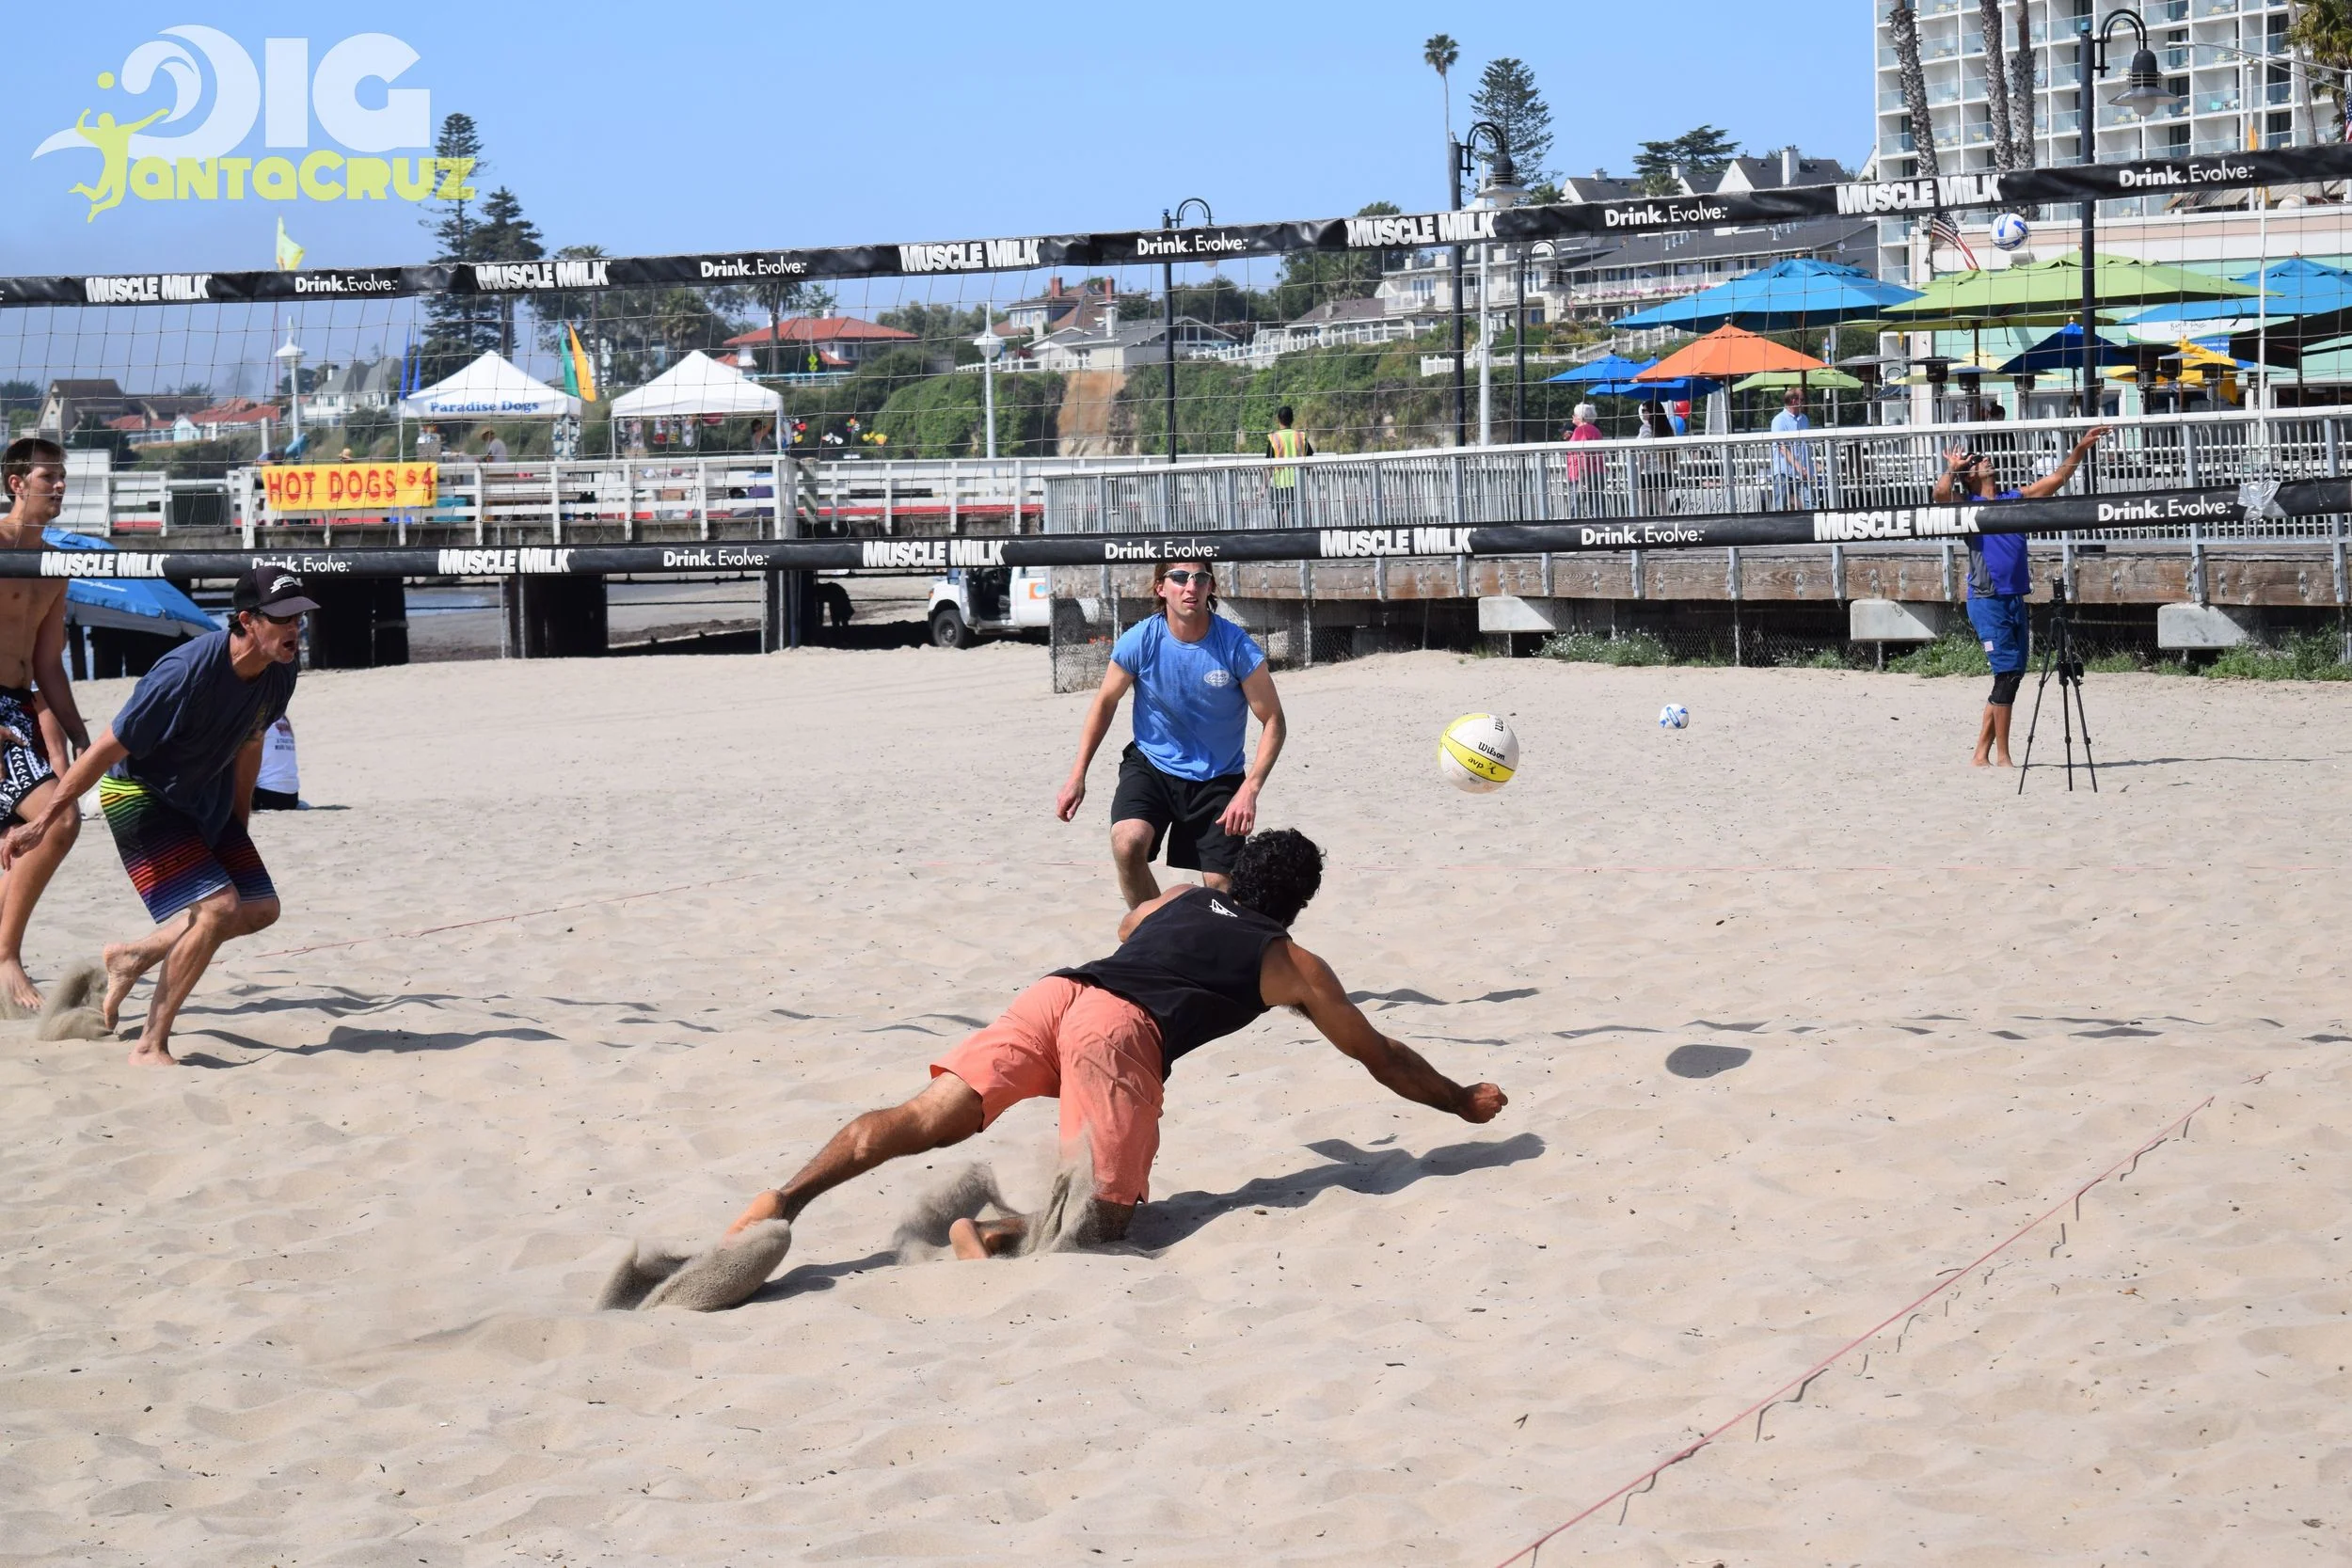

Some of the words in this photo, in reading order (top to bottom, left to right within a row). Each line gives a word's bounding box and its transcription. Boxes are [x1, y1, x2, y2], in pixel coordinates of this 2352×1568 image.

[2119, 165, 2187, 187] Drink.
[1836, 184, 1935, 215] MUSCLE
[1937, 174, 2002, 206] MILK
[1604, 204, 1668, 227] Drink.
[1348, 220, 1435, 246] MUSCLE
[1438, 210, 1496, 241] MILK
[900, 245, 983, 272] MUSCLE
[987, 239, 1041, 267] MILK
[1136, 235, 1193, 256] Drink.
[475, 262, 554, 291] MUSCLE
[556, 261, 610, 288] MILK
[700, 260, 755, 278] Drink.
[85, 276, 159, 303] MUSCLE
[161, 273, 211, 300] MILK
[294, 274, 348, 293] Drink.
[430, 401, 497, 413] Paradise
[501, 401, 539, 413] Dogs
[267, 471, 316, 504] HOT
[329, 469, 396, 502] DOGS
[406, 467, 435, 501] $4
[2098, 499, 2165, 522] Drink.
[1813, 510, 1912, 542] MUSCLE
[1914, 505, 1981, 536] MILK
[1320, 531, 1409, 558] MUSCLE
[1412, 527, 1475, 555] MILK
[1581, 527, 1642, 546] Drink.
[437, 548, 517, 575] MUSCLE
[518, 547, 572, 574] MILK
[663, 548, 716, 567] Drink.
[862, 540, 946, 567] MUSCLE
[949, 540, 1005, 566] MILK
[1104, 541, 1162, 560] Drink.
[40, 551, 115, 578] MUSCLE
[116, 552, 167, 578] MILK
[1468, 756, 1485, 769] avp
[1478, 741, 1505, 761] Wilson
